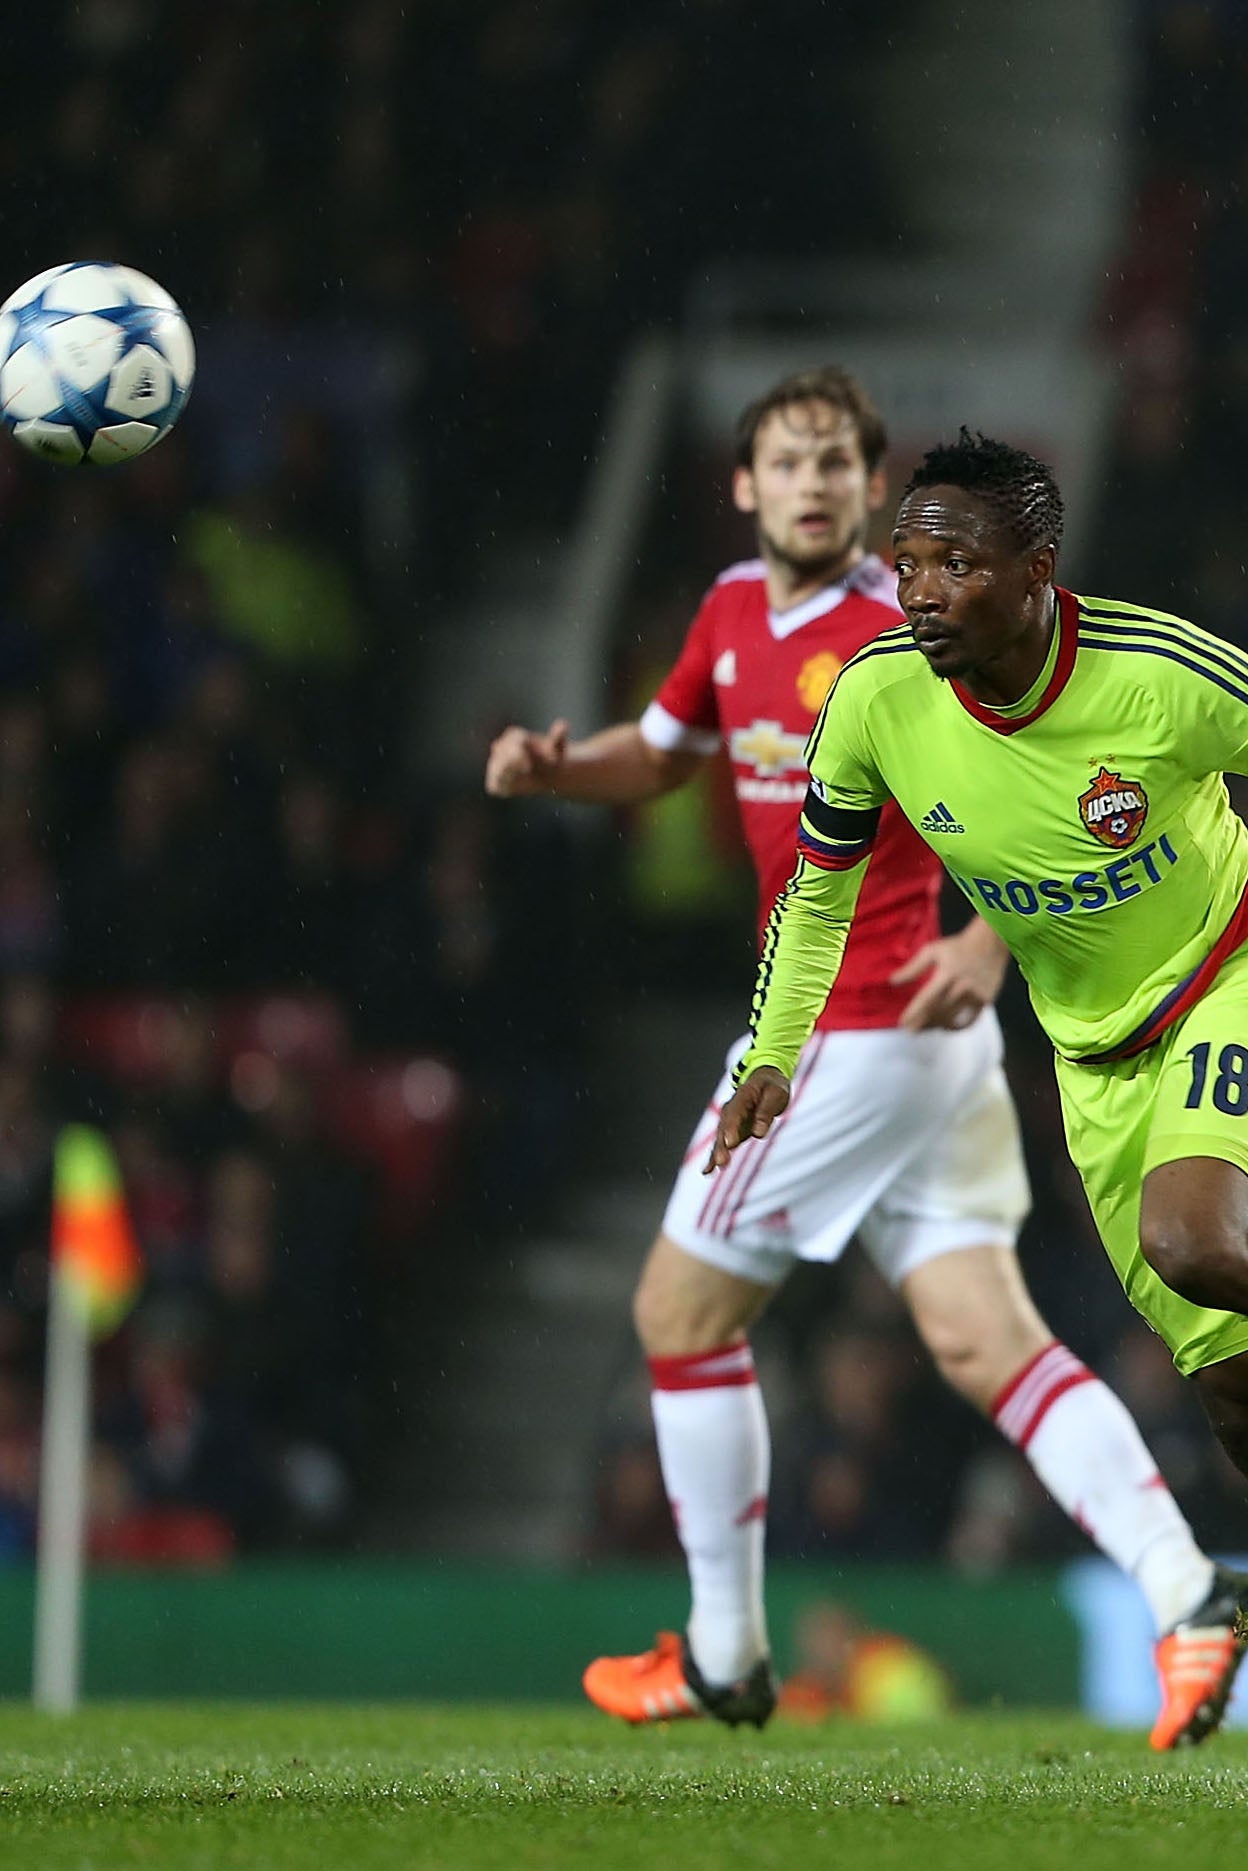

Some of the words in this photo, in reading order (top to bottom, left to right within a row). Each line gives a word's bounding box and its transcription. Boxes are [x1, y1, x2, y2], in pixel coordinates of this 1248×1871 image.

[1087, 791, 1142, 822] ЦСКА
[921, 821, 965, 834] adidas
[972, 833, 1178, 915] ROSSETI
